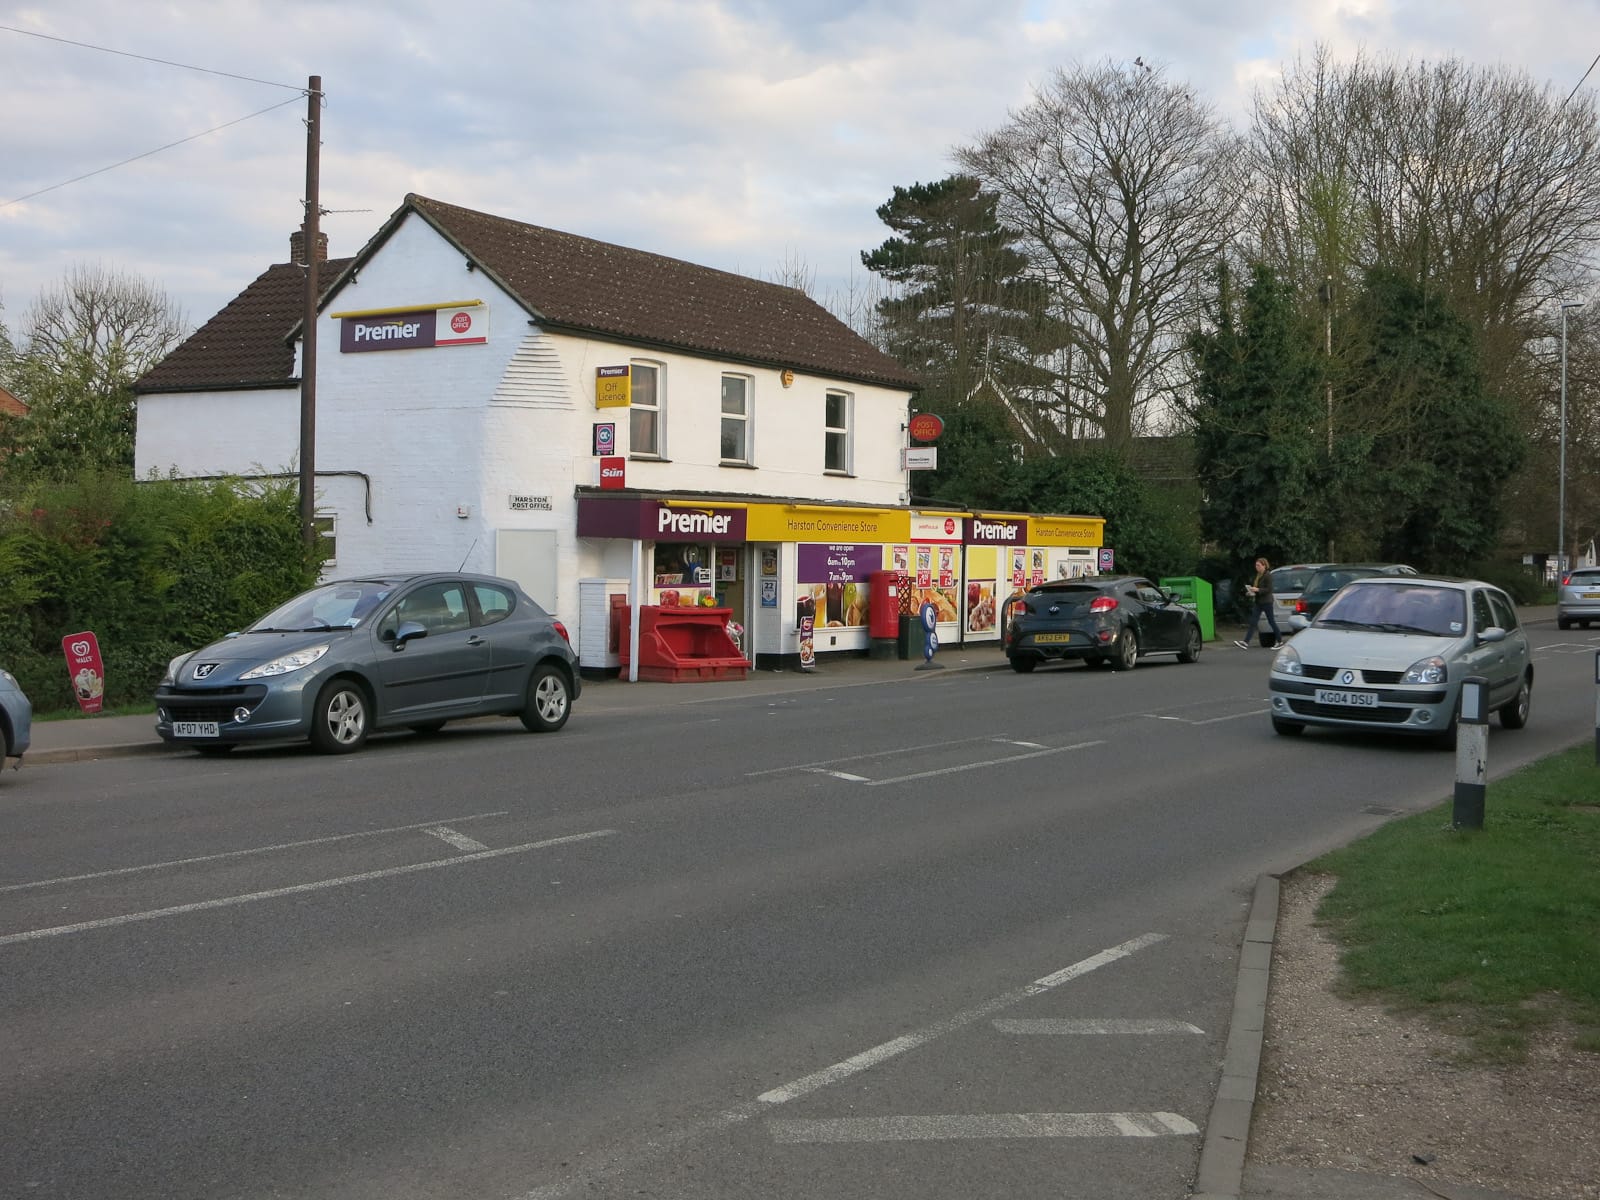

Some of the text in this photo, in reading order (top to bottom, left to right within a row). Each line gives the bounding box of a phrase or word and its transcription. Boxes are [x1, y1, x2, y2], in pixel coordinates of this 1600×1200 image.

[354, 321, 420, 342] Premier
[605, 382, 617, 391] Off
[599, 392, 626, 401] Licence
[601, 468, 624, 477] Sun
[658, 508, 731, 534] Premier
[787, 520, 877, 532] Harston Convenience Store
[973, 520, 1018, 540] Premier
[1036, 528, 1095, 538] Harston Convenience Store
[827, 557, 838, 565] 6am
[841, 557, 855, 568] 10pm
[829, 572, 839, 581] 7am
[842, 572, 853, 582] 9pm
[1320, 691, 1373, 705] KG04 DSU
[177, 724, 216, 734] AF07 YHD
